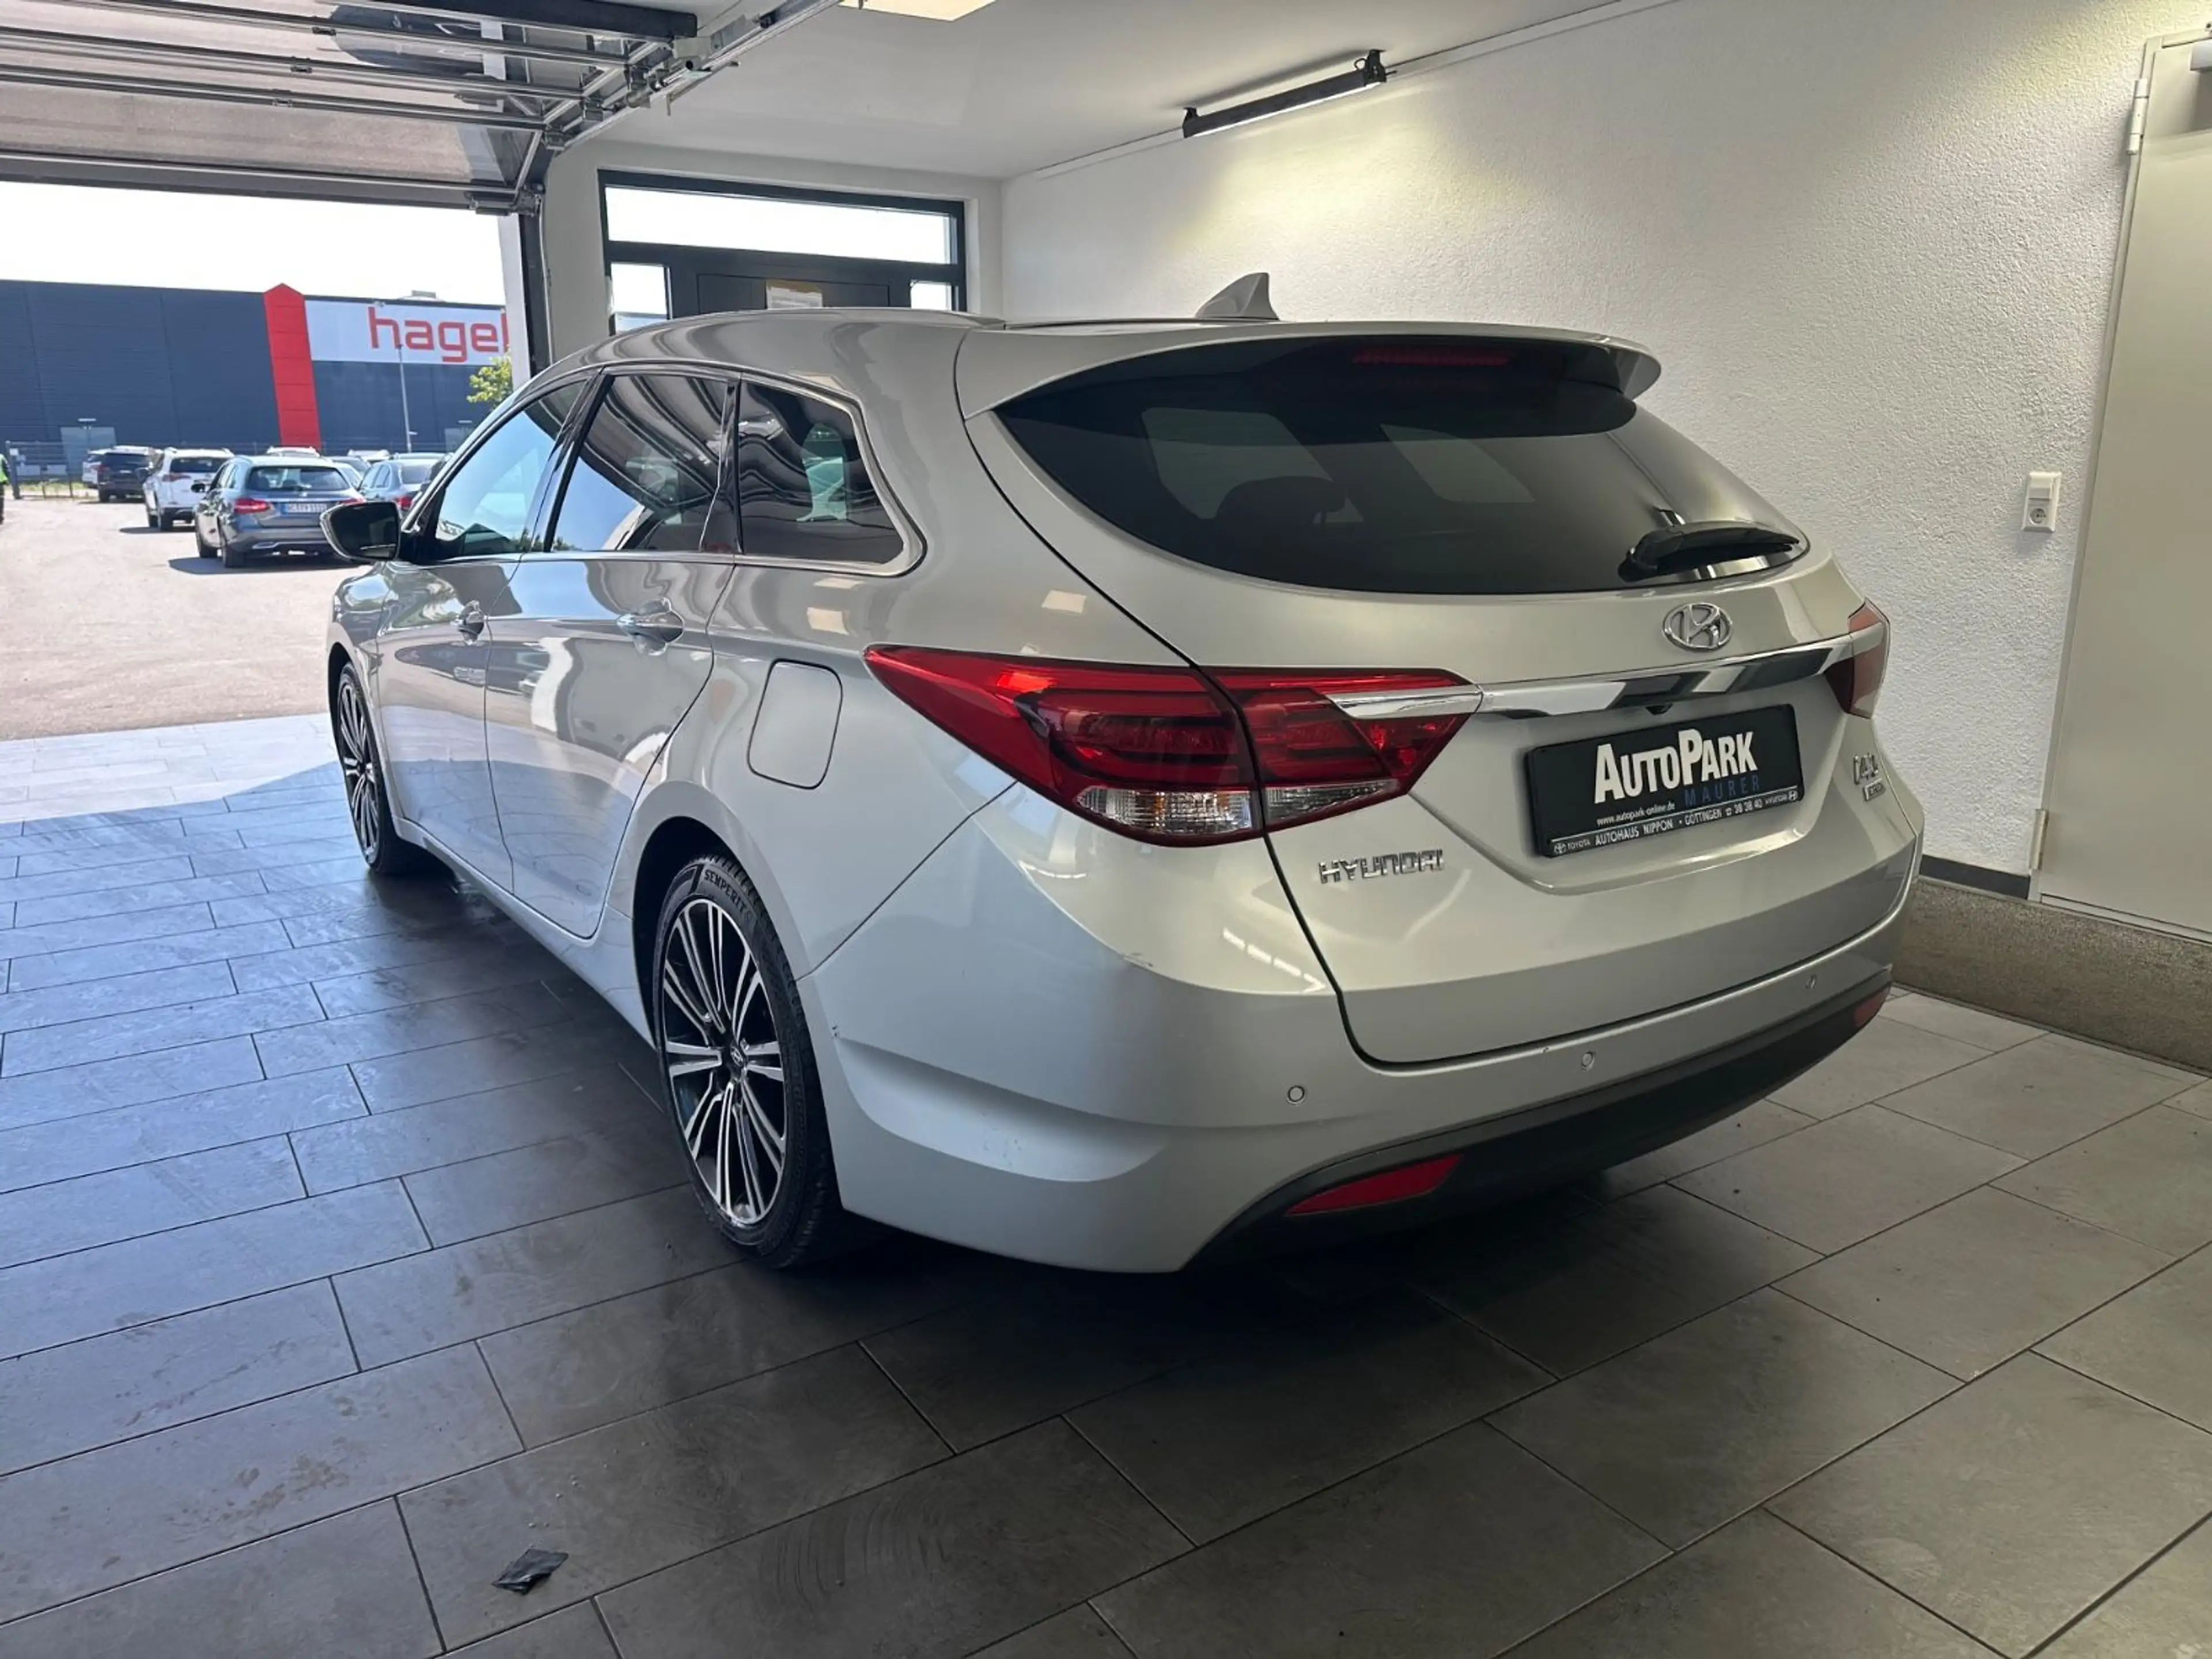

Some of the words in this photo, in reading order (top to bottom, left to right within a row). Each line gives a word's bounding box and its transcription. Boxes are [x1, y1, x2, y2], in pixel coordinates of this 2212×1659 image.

[368, 306, 510, 363] hagel
[1684, 775, 1760, 806] MAURER
[1567, 839, 1590, 850] TOYOTA
[1595, 826, 1639, 846] AUTOHAUS
[1643, 819, 1673, 835] NIPPON
[1319, 849, 1443, 884] HYUNDAI
[704, 869, 747, 913] SEMPERIT
